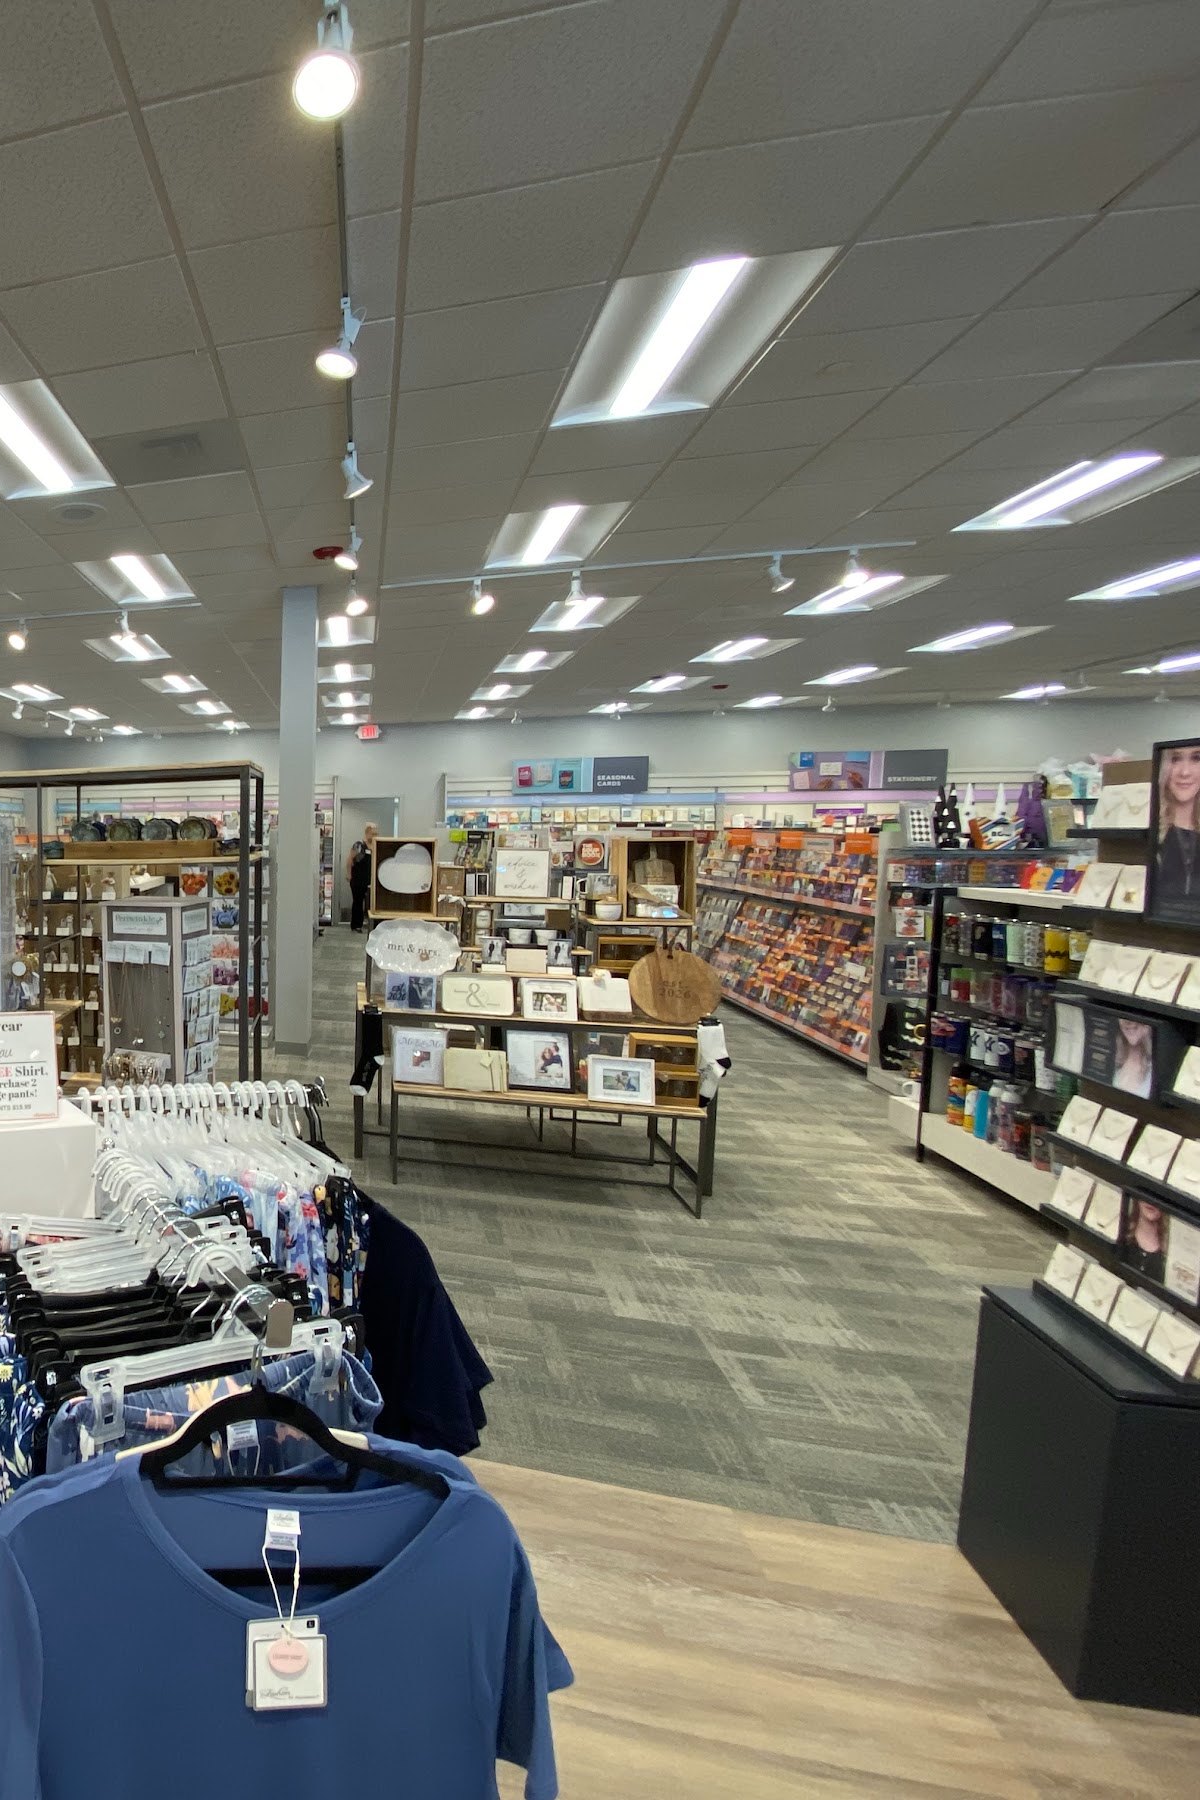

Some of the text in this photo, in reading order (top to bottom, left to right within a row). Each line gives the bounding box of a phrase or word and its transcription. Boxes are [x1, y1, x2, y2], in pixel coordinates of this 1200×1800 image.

[407, 943, 416, 954] &
[659, 987, 691, 999] 2026
[15, 1065, 48, 1077] Shirt.
[31, 1079, 37, 1087] 2
[8, 1089, 38, 1100] pants!
